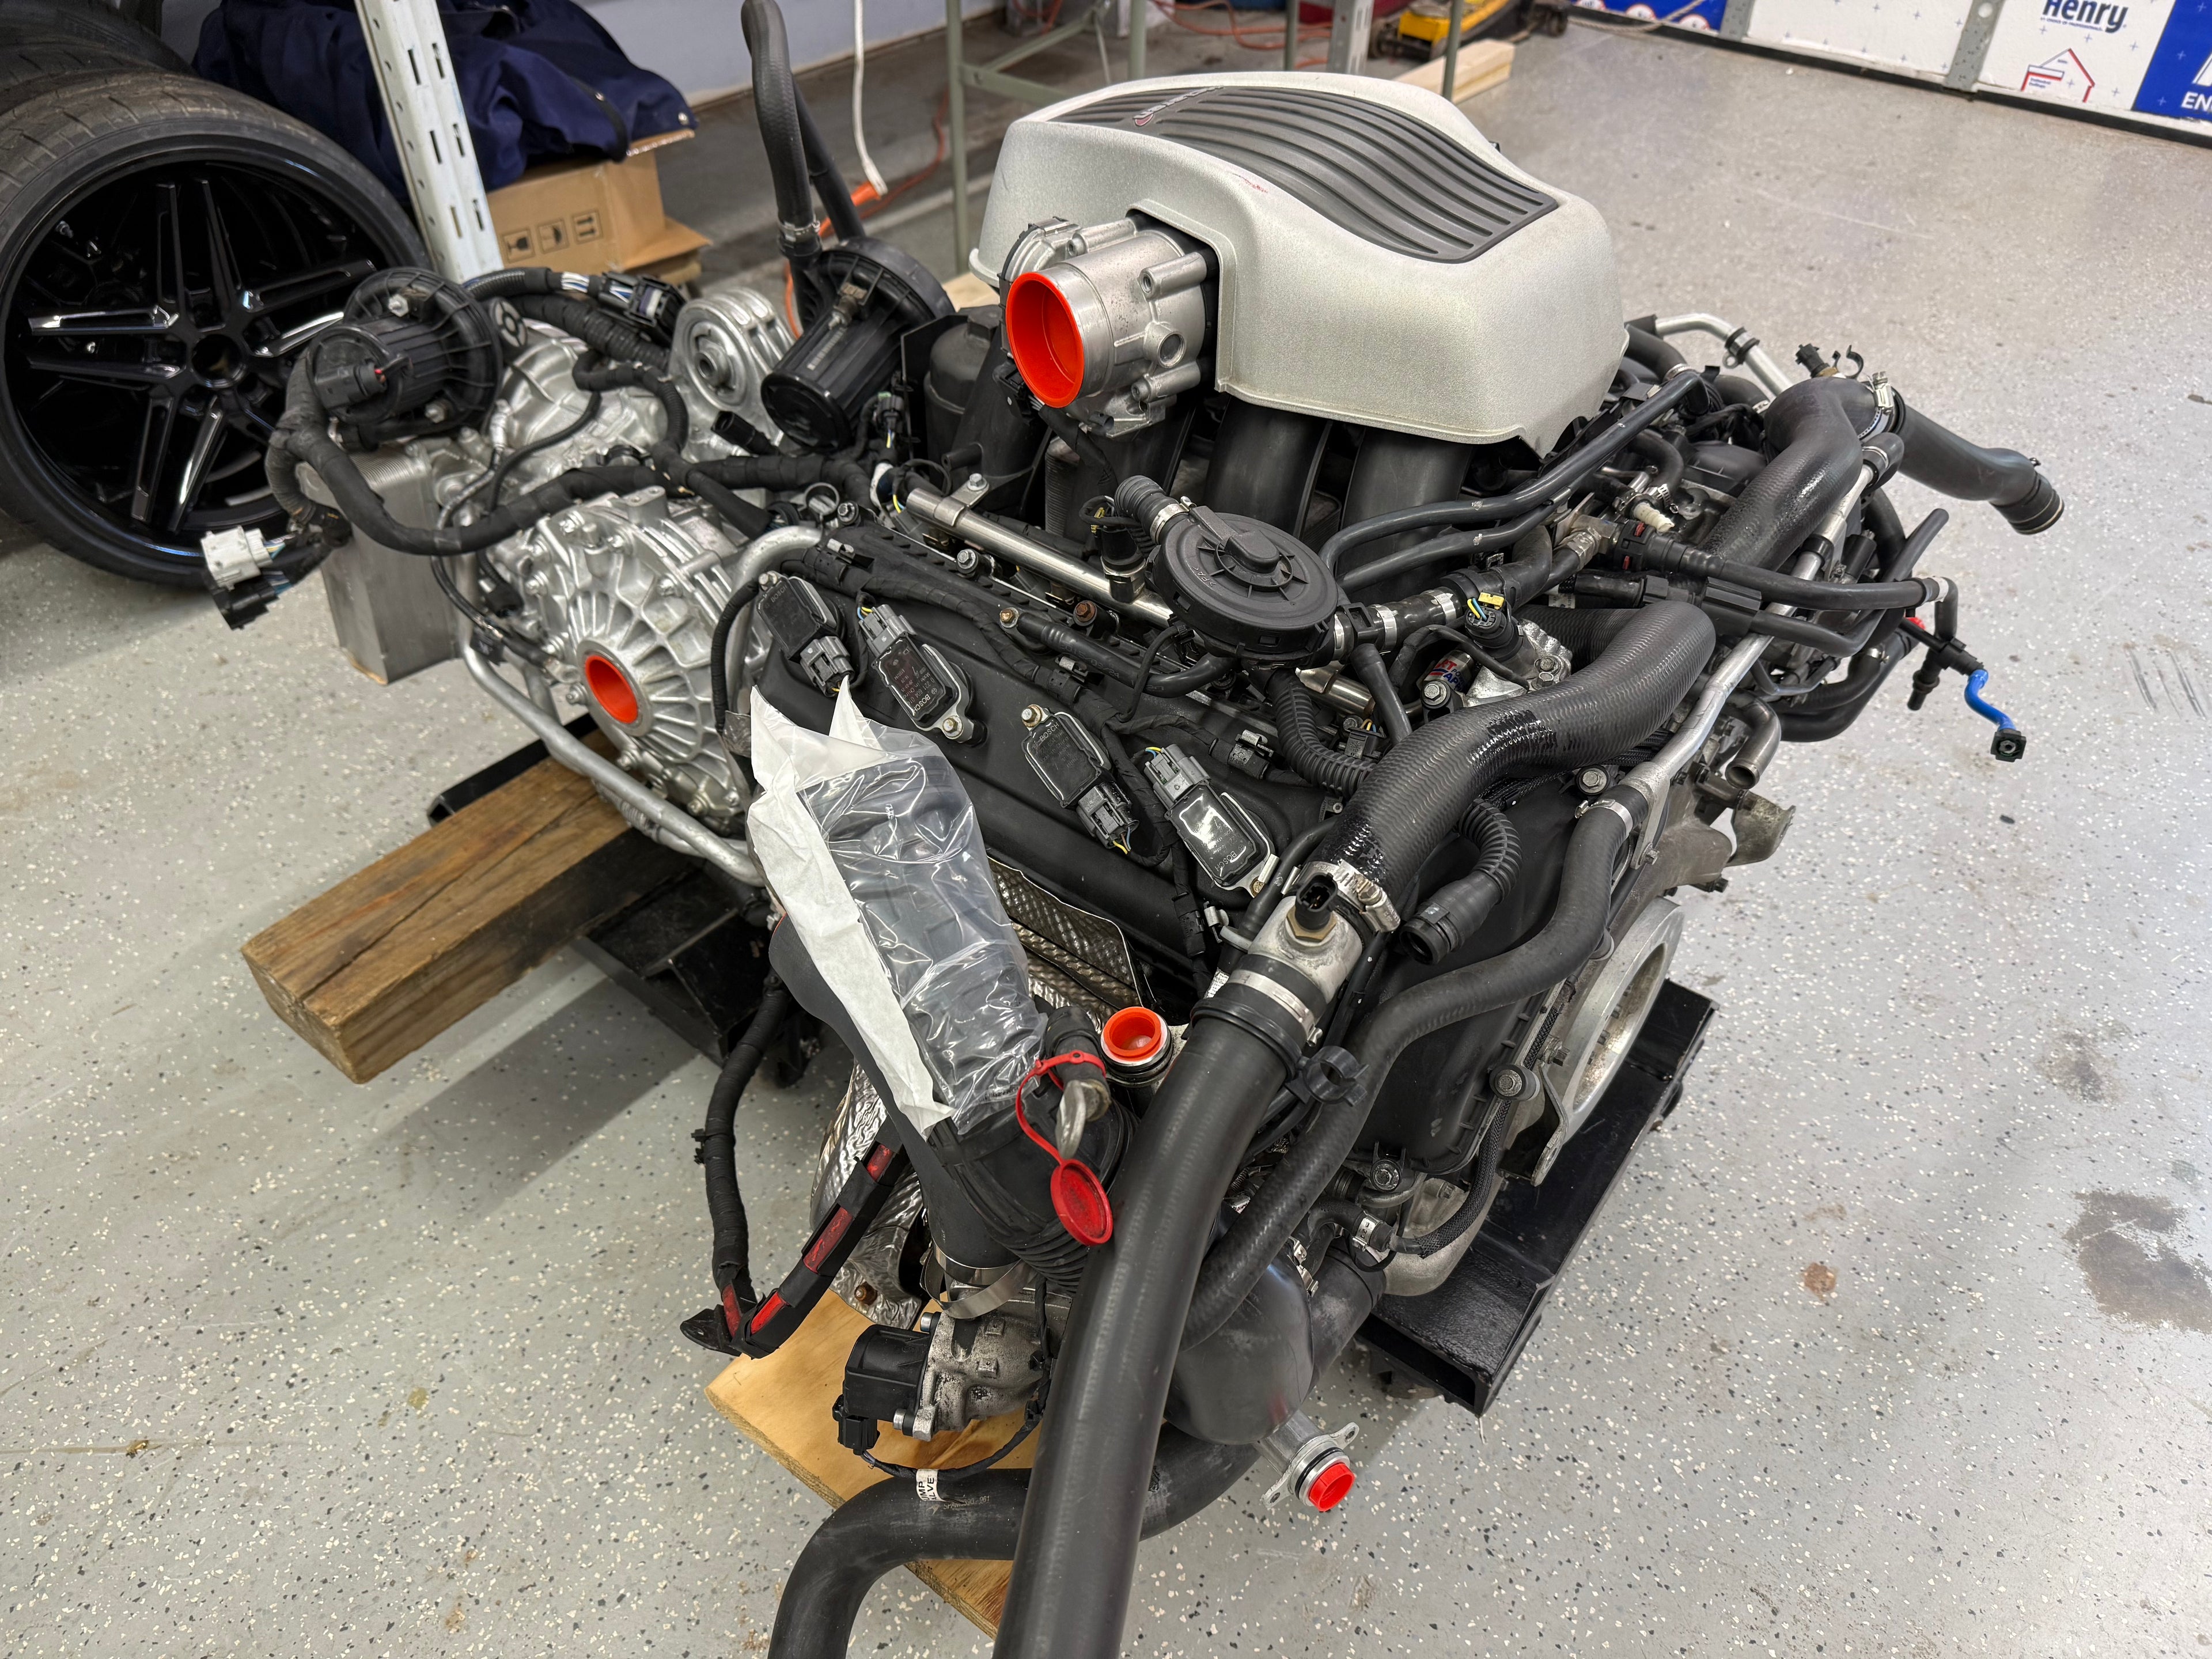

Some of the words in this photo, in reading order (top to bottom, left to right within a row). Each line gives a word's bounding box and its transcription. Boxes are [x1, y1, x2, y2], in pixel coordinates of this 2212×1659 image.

[2042, 0, 2129, 33] Henry
[2181, 92, 2212, 113] EN
[770, 584, 789, 603] BOSCH
[912, 694, 931, 713] BOSCH
[1040, 722, 1059, 741] BOSCH
[1214, 850, 1237, 872] BOSCH
